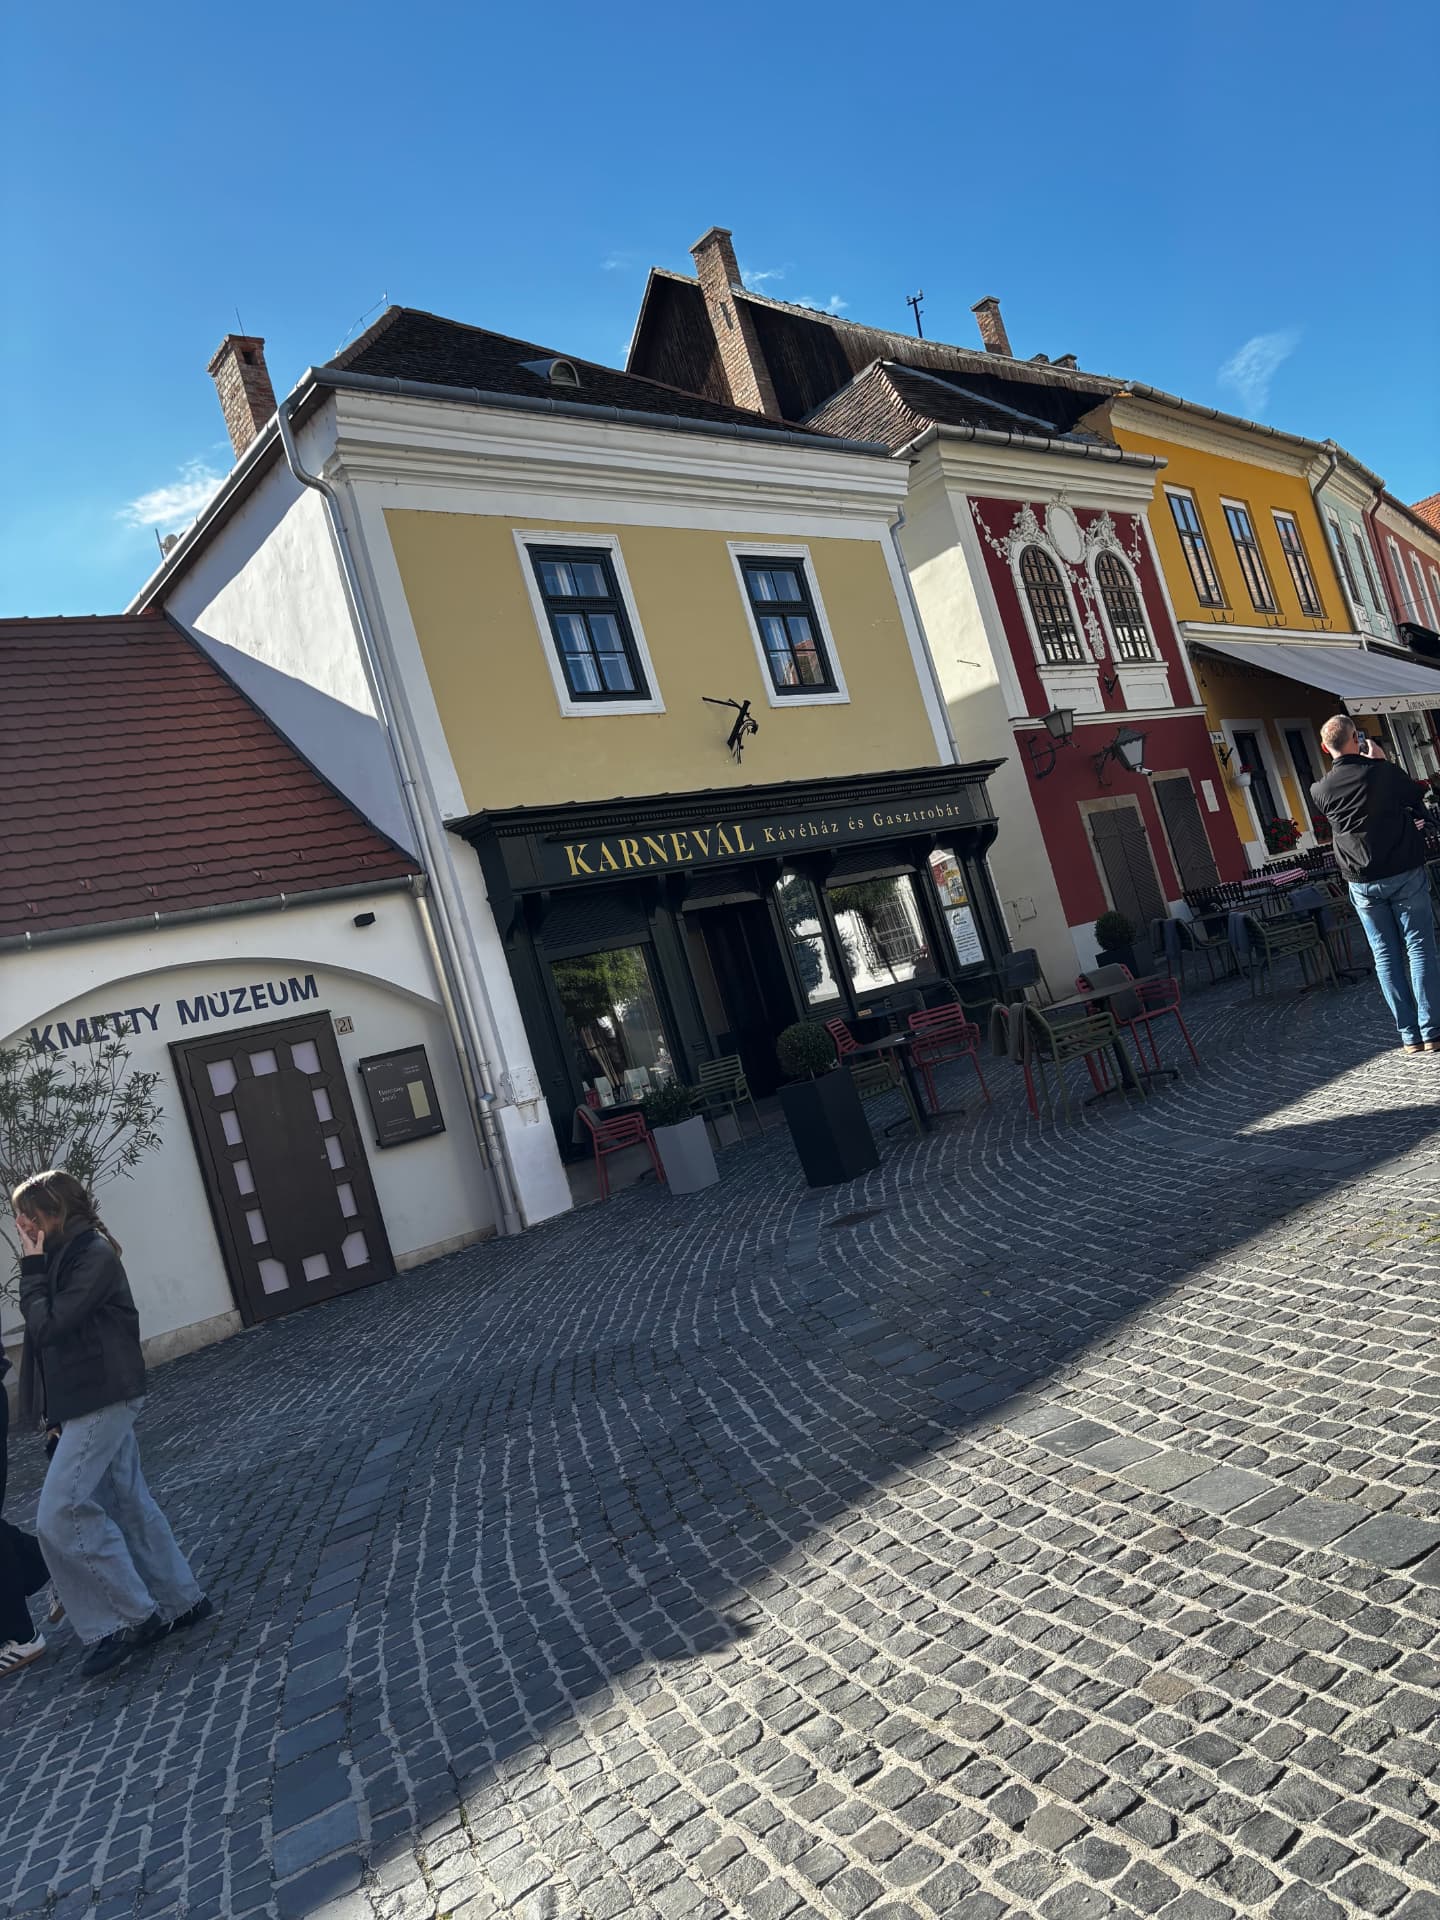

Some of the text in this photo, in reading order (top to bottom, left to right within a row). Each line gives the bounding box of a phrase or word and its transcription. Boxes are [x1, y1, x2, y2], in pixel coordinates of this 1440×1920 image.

[564, 804, 960, 876] KARNEVÁL Kávéház és Gasztrobár
[30, 1004, 161, 1053] KMETTY
